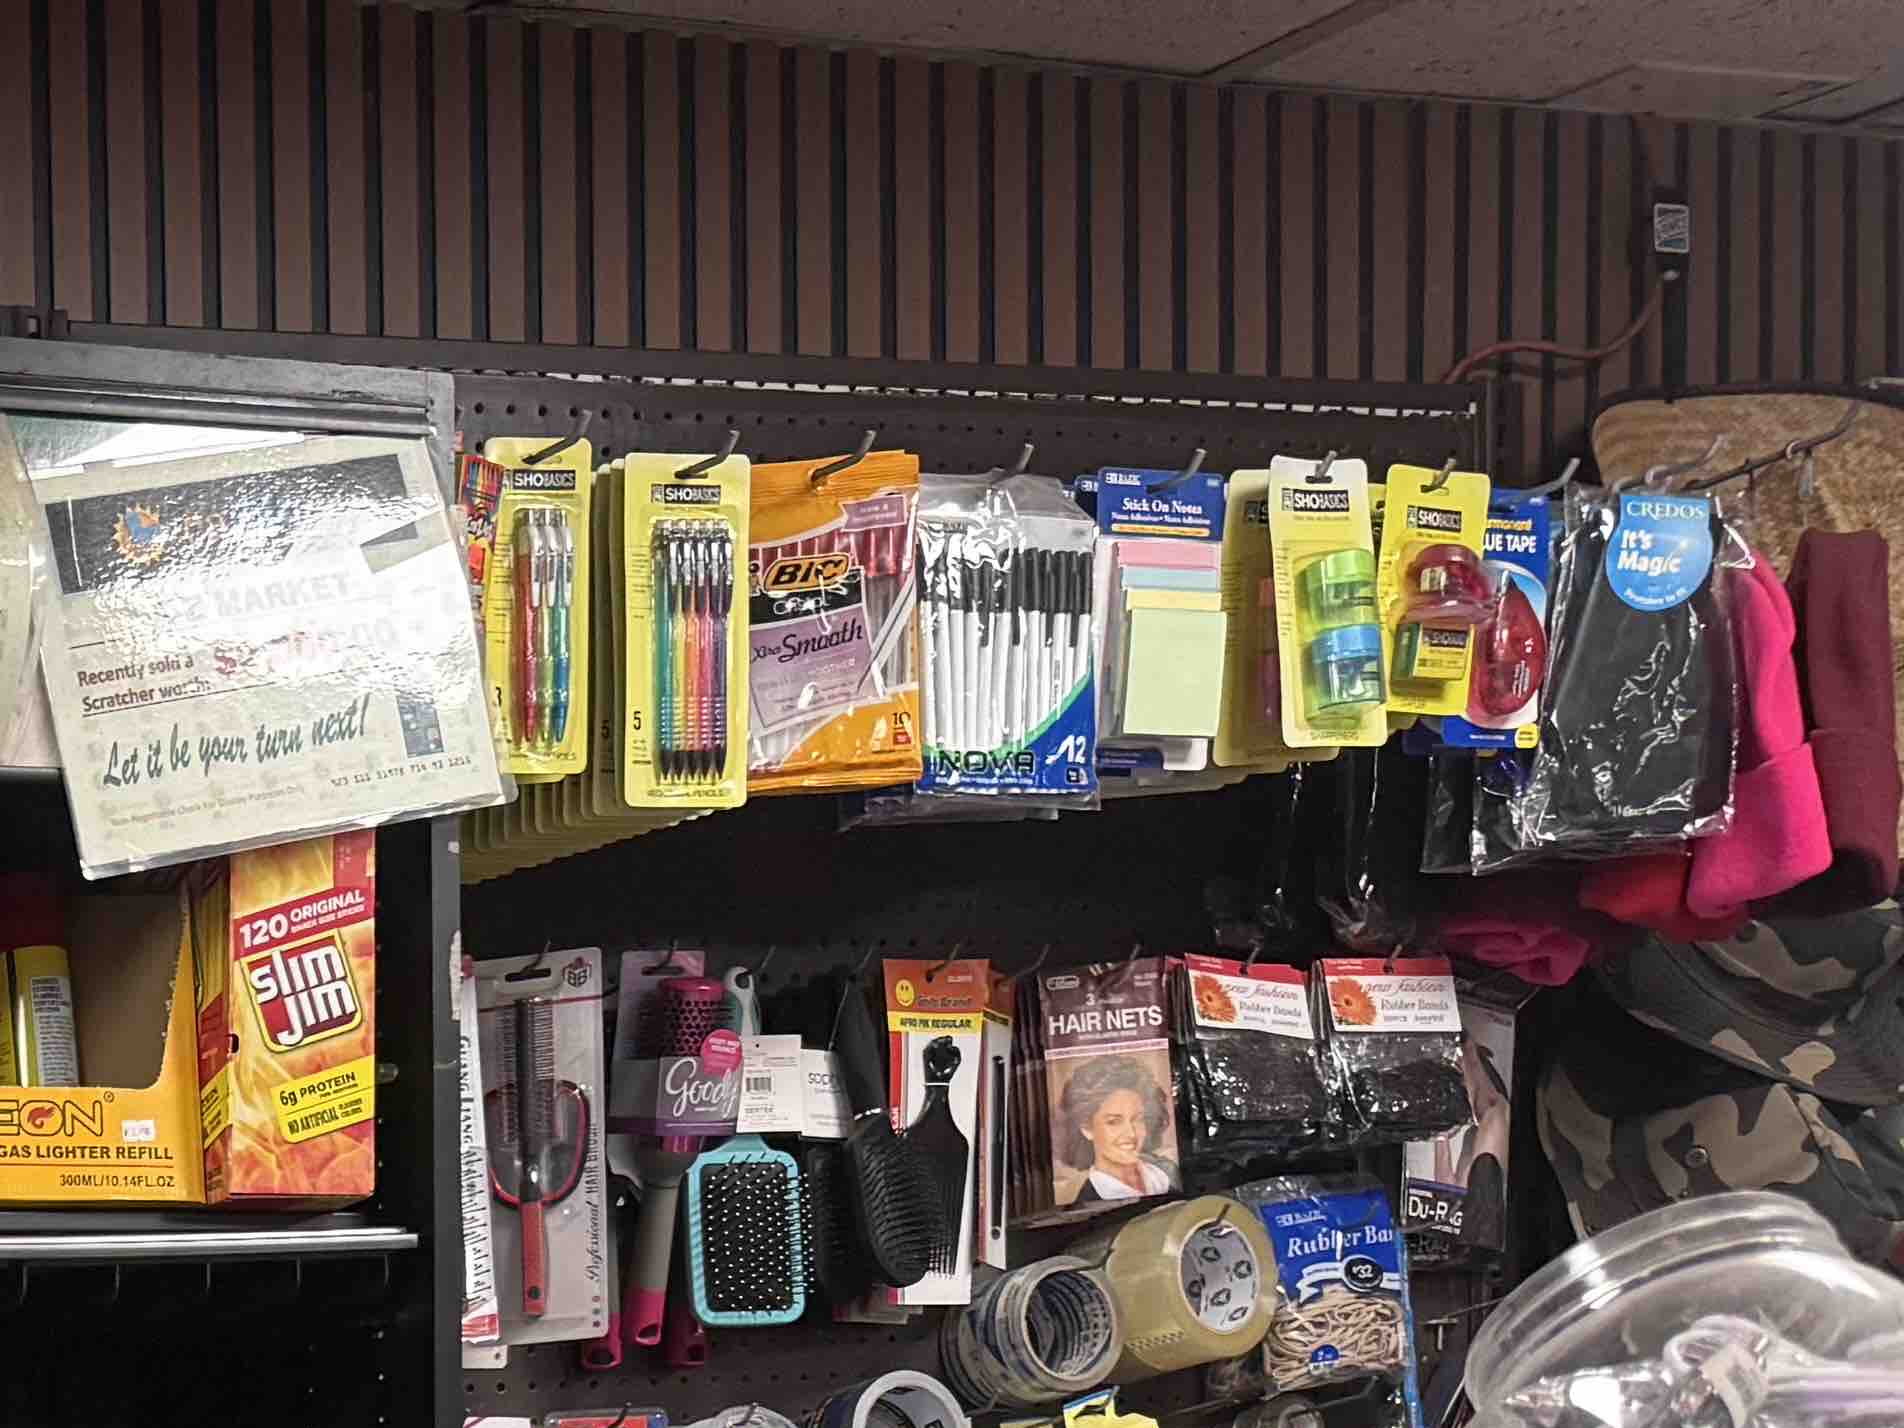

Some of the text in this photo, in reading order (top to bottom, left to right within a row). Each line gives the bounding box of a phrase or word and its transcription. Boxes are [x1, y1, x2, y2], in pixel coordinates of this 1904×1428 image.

[1626, 502, 1706, 519] CREDOS
[778, 620, 862, 663] Smooth
[240, 890, 364, 948] 120 ORIGINAL
[250, 946, 347, 1004] slim
[1049, 1005, 1162, 1035] HAIR NETS
[300, 1072, 355, 1097] PROTEIN
[665, 1058, 737, 1117] Goody
[37, 1145, 110, 1159] LIGHTER
[116, 1146, 173, 1160] REFILL
